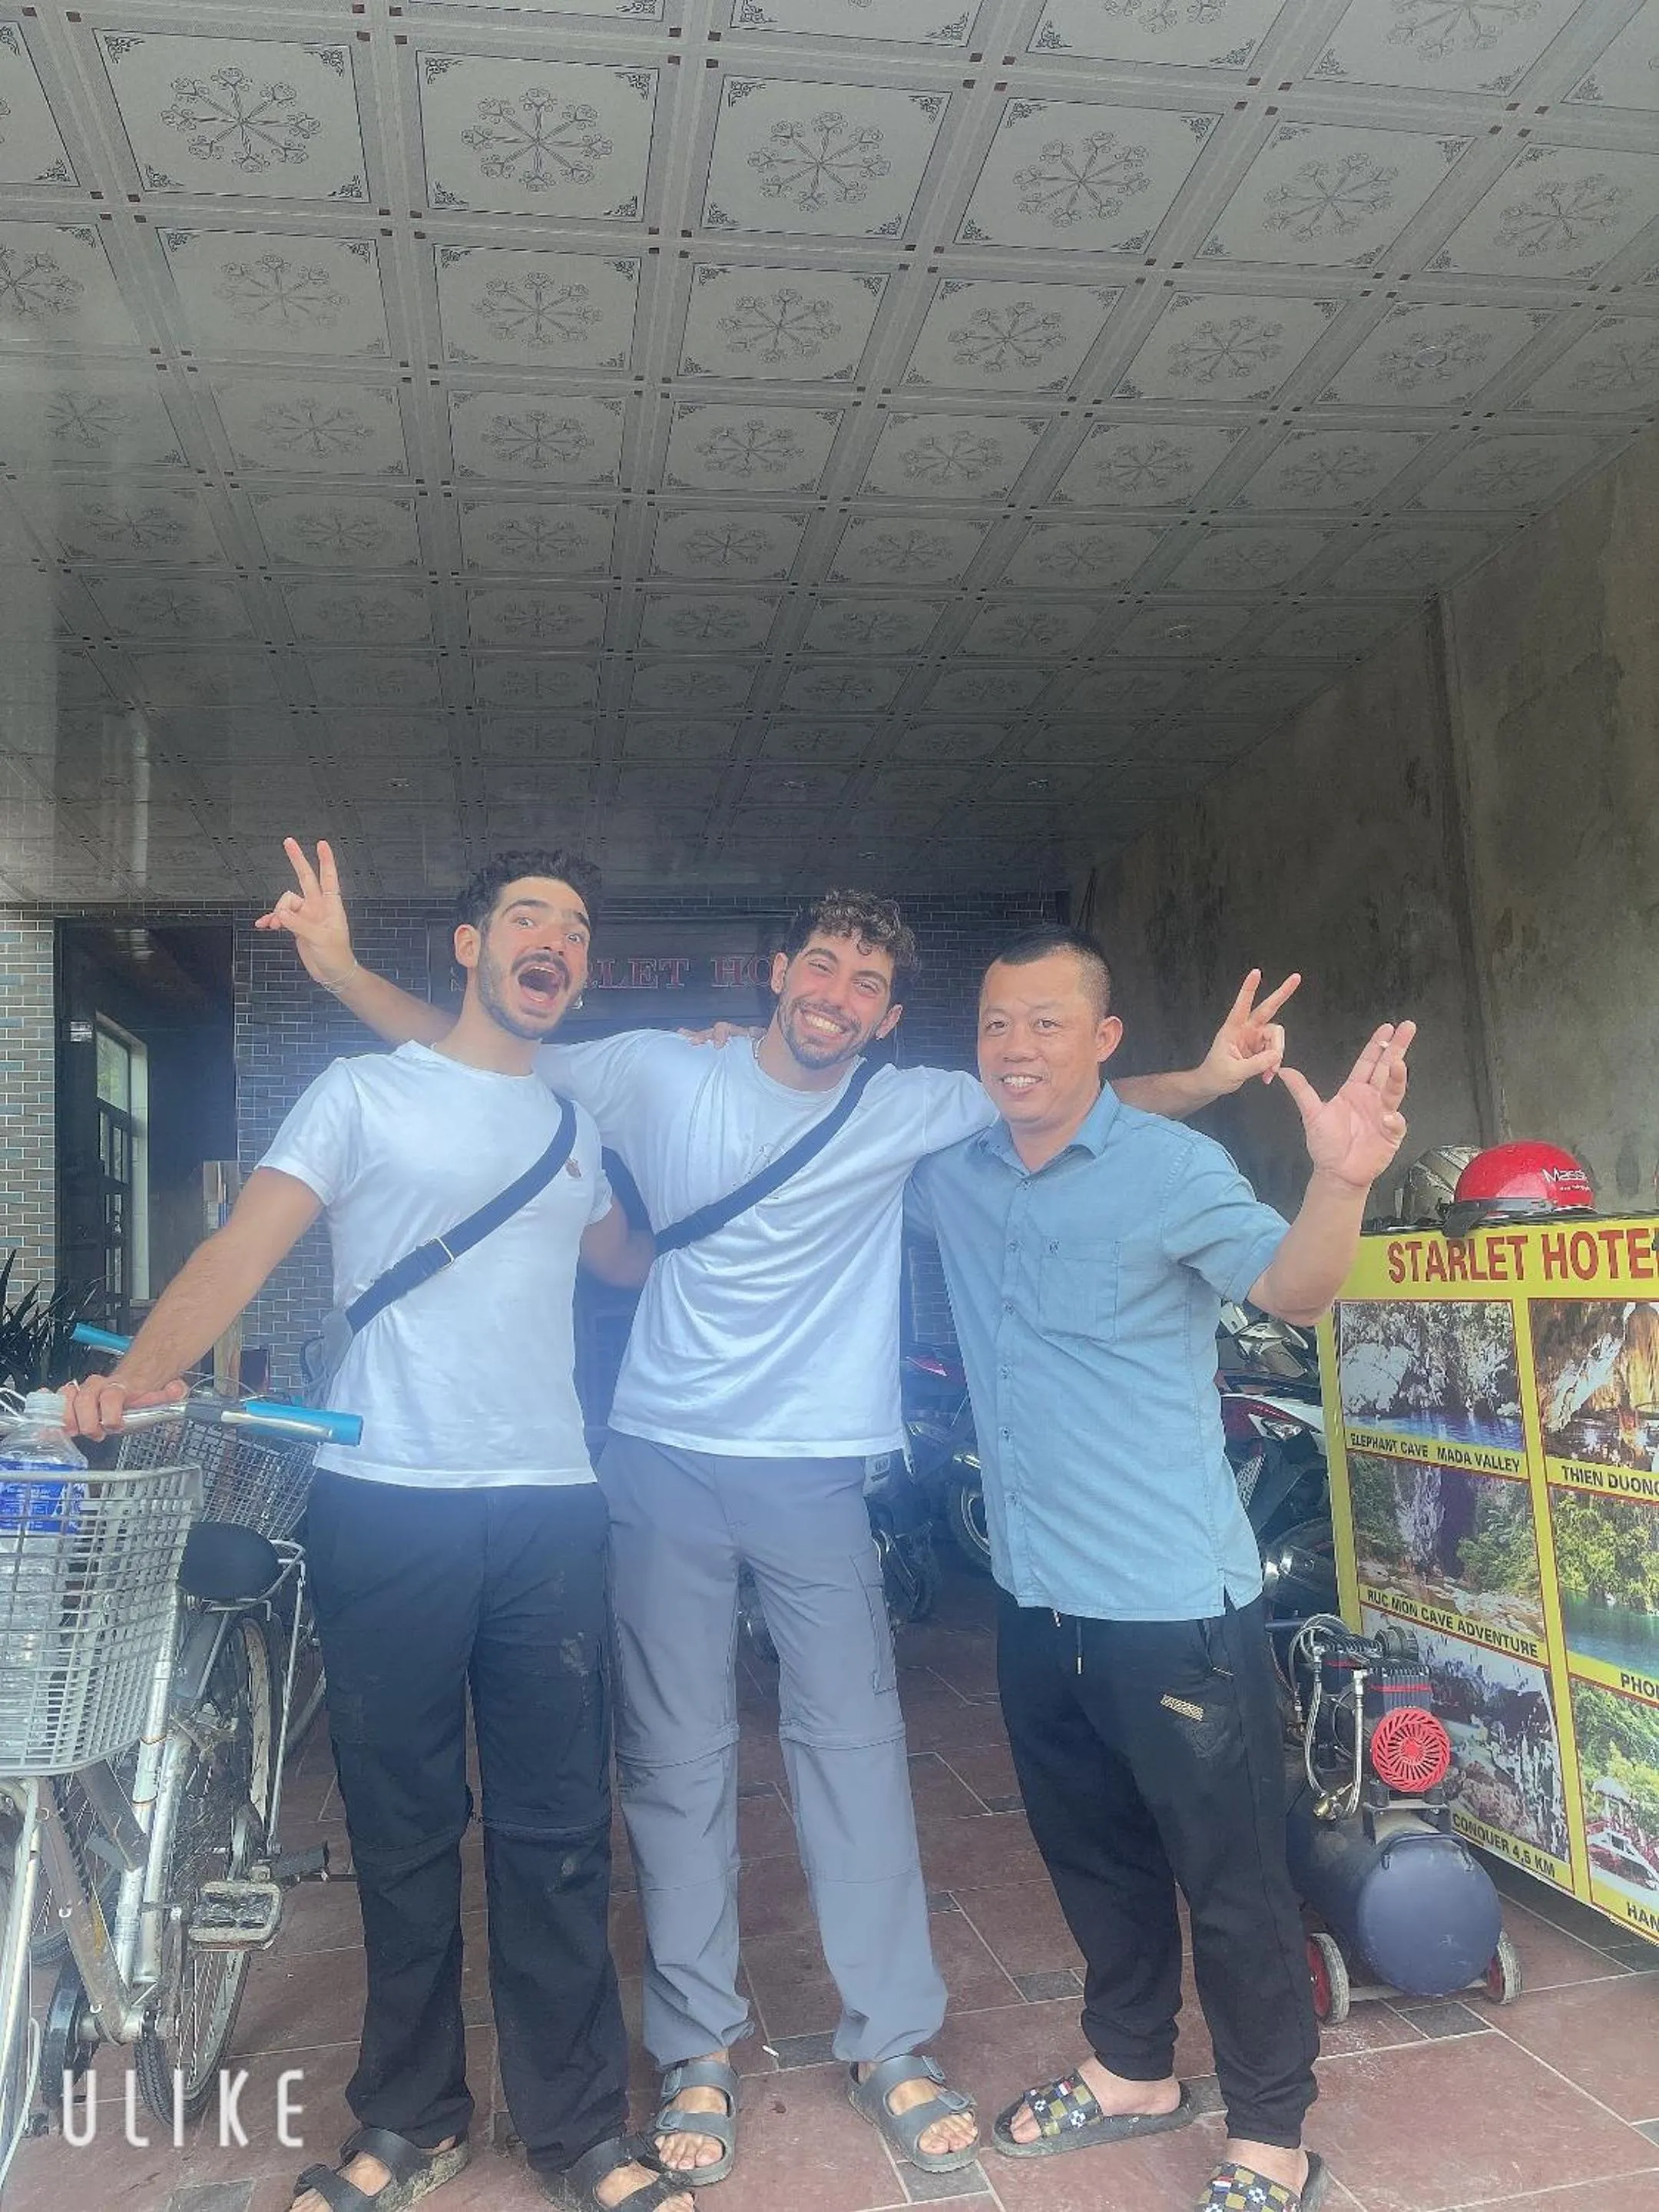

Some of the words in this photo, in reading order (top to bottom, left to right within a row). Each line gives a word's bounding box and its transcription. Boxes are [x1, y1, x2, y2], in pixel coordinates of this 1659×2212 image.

[1387, 1235, 1528, 1283] STARLET
[1541, 1227, 1659, 1281] HOTE
[1350, 1433, 1396, 1453] ELEPHANT
[1400, 1442, 1428, 1458] CAVE
[1437, 1447, 1472, 1465] MADA
[1474, 1452, 1520, 1473] VALLEY
[1561, 1465, 1604, 1487] THIEN
[1368, 1589, 1389, 1606] RUC
[1391, 1597, 1418, 1617] MON
[1421, 1608, 1454, 1629] CAVE
[1457, 1620, 1538, 1658] ADVENTURE
[1452, 1813, 1509, 1854] CONQUER
[1535, 1854, 1555, 1878] KM
